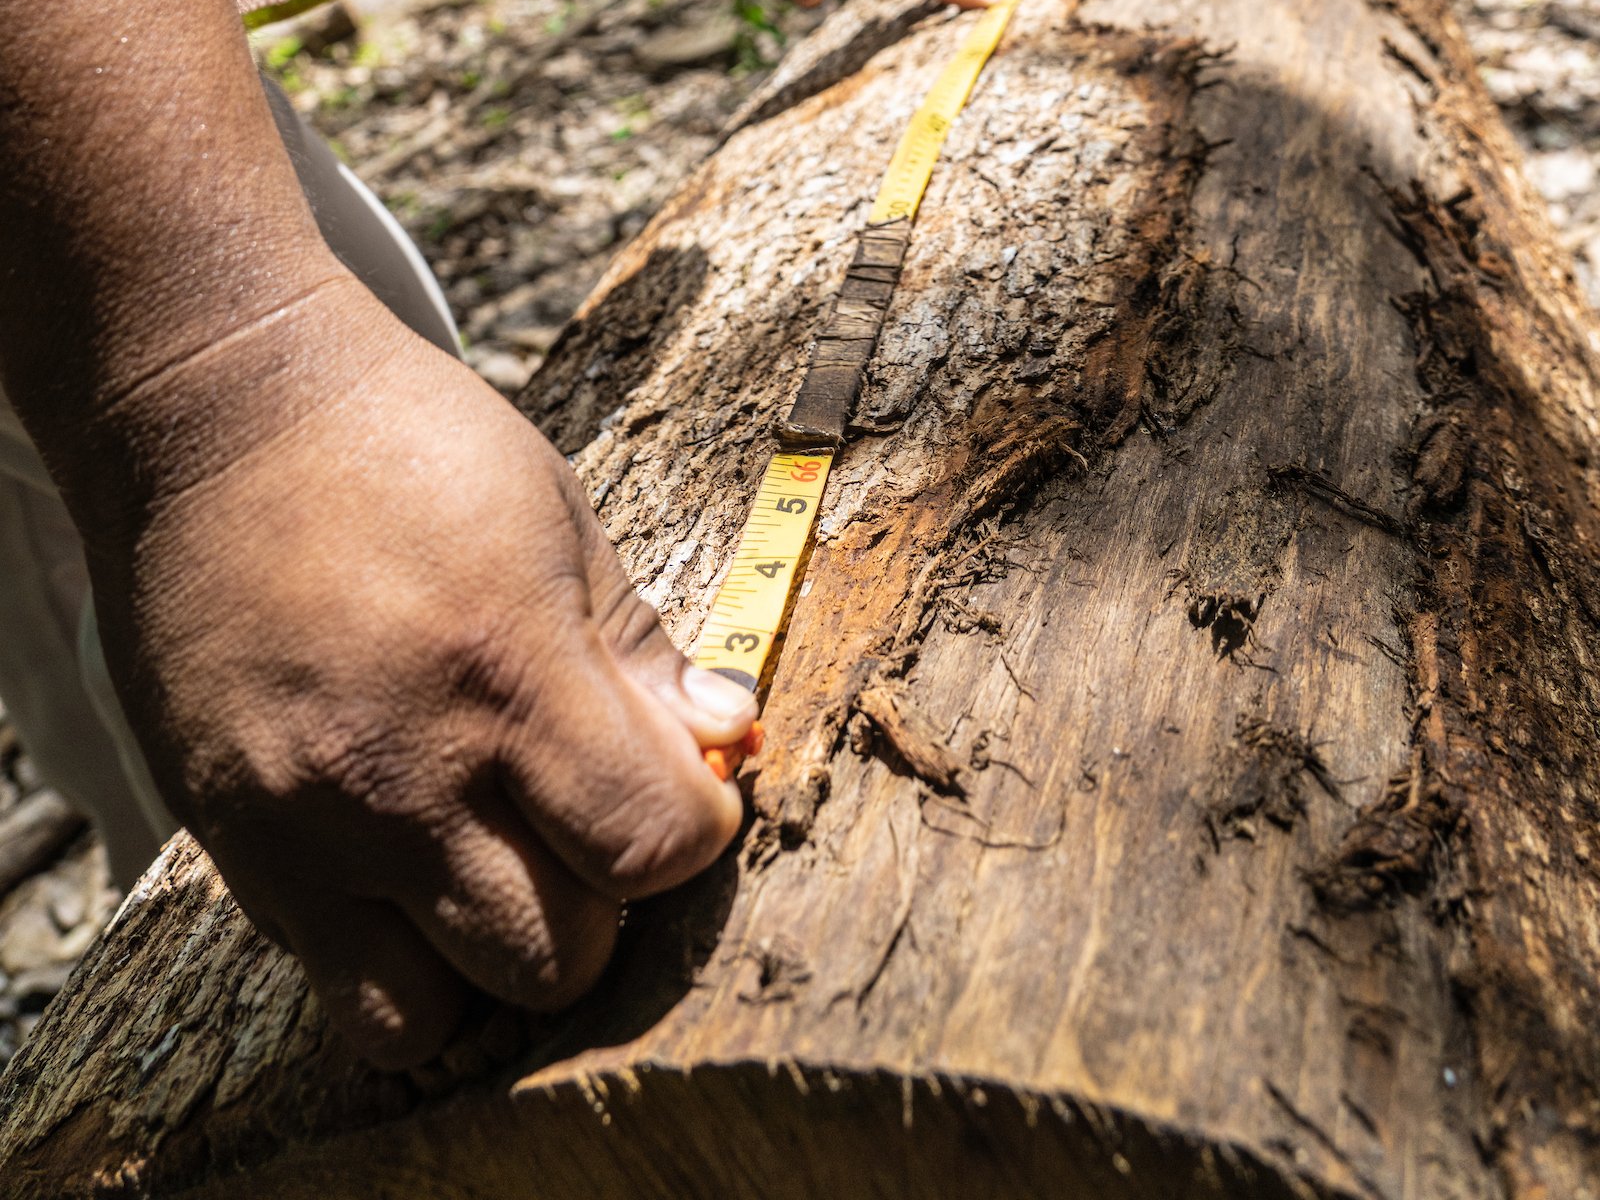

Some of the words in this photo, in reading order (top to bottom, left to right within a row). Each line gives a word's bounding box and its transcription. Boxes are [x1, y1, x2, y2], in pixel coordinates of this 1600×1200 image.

[790, 460, 822, 482] 66
[776, 497, 807, 514] 5
[755, 561, 786, 578] 4
[725, 632, 760, 653] 3
